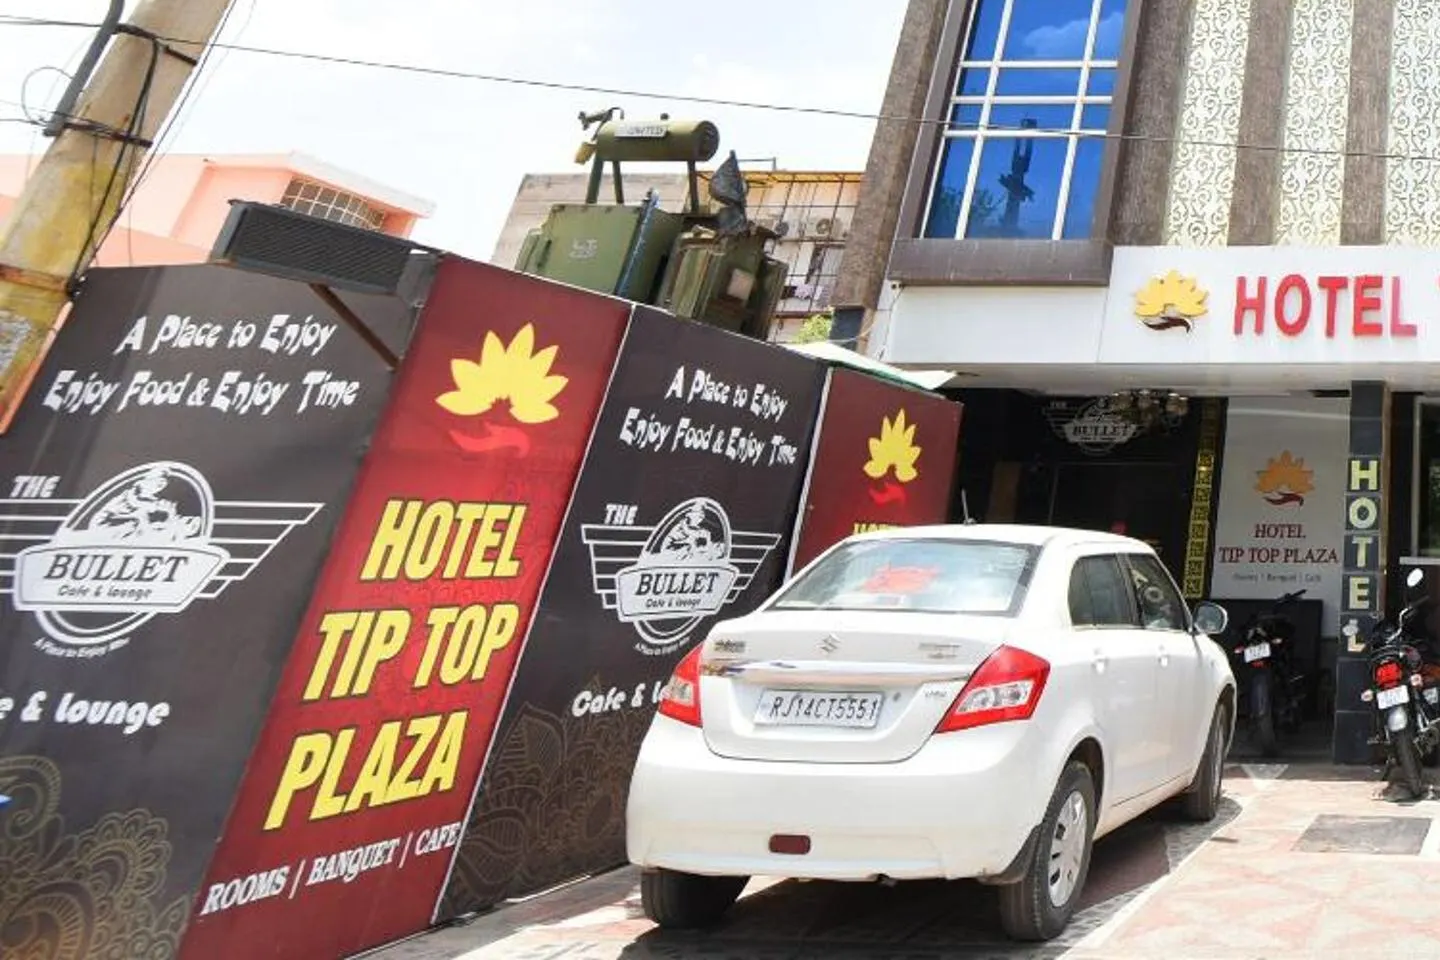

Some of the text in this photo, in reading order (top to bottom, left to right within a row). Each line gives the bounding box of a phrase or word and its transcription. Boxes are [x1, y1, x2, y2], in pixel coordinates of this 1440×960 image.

[1233, 273, 1418, 338] HOTEL
[113, 314, 338, 356] A Place to Enjoy
[42, 370, 360, 416] Enjoy Food & Enjoy Time
[664, 365, 789, 423] A Place to Enjoy
[619, 407, 798, 467] Enjoy Food & Enjoy Time
[10, 475, 60, 498] THE
[604, 504, 638, 525] THE
[1254, 523, 1306, 538] HOTEL
[359, 499, 527, 581] HOTEL
[1219, 547, 1339, 563] TIP TOP PLAZA
[1347, 459, 1378, 652] HOTEL
[44, 553, 188, 583] BULLET
[635, 572, 721, 596] BULLET
[302, 603, 520, 702] TIP TOP
[20, 691, 47, 722] &
[54, 692, 170, 735] lounge
[571, 687, 627, 717] Cafe
[262, 710, 469, 832] PLAZA
[199, 865, 291, 916] ROOMS
[306, 837, 401, 886] BANQUET
[414, 821, 462, 856] CAFE
